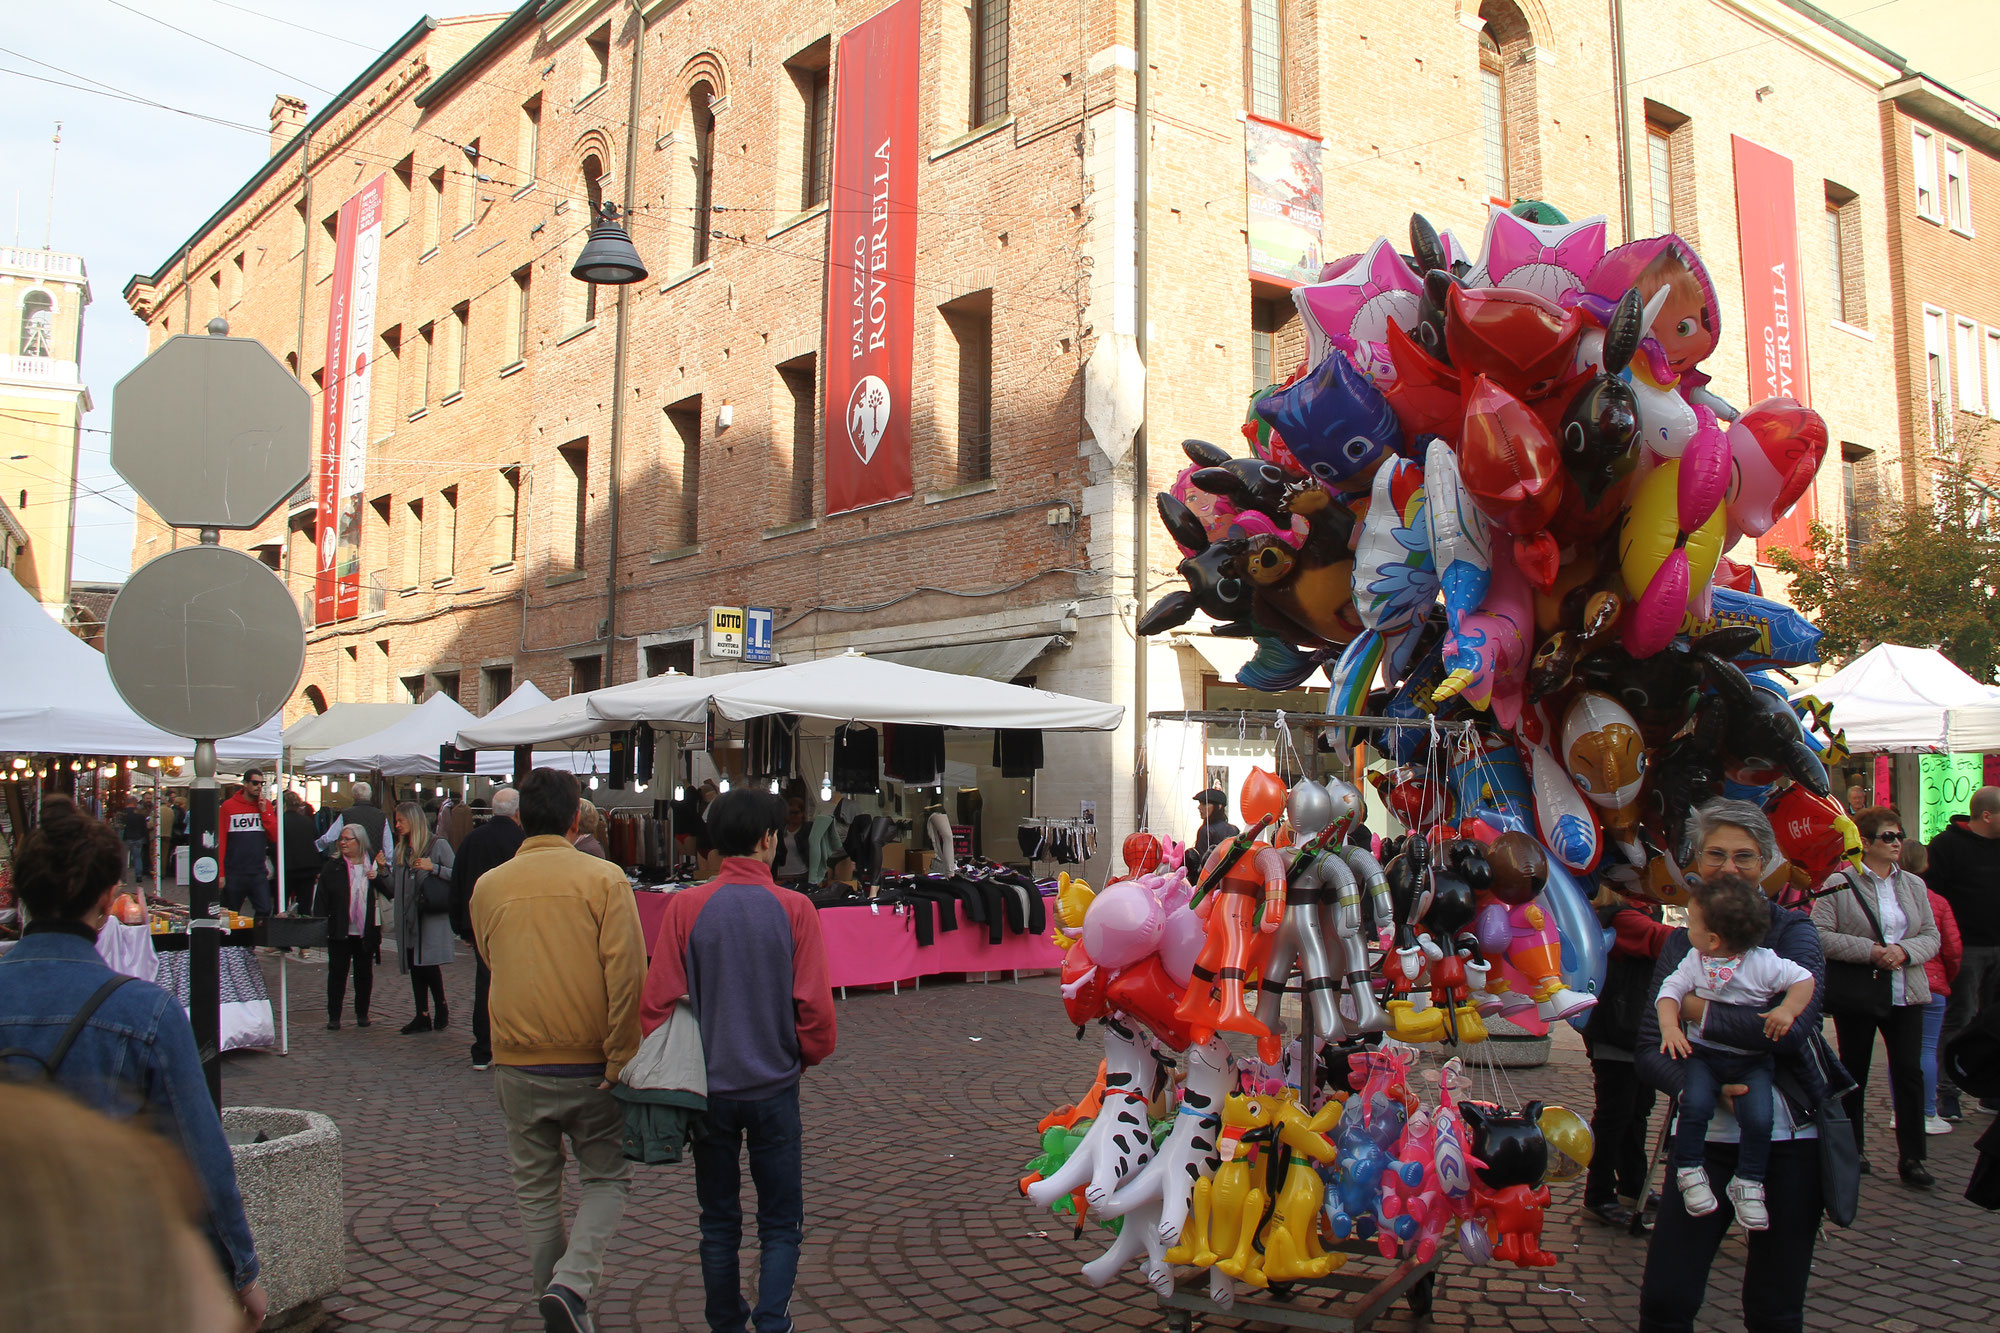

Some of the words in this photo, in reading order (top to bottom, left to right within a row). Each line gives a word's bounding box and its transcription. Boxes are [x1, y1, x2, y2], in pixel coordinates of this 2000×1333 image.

[869, 136, 891, 353] ROVERELLA
[852, 235, 866, 360] PALAZZO
[330, 293, 344, 416] ROVERELLA
[1763, 326, 1777, 399] LAZZO
[326, 422, 337, 514] PALAZZO
[717, 613, 741, 628] LOTTO
[749, 610, 771, 647] T
[1711, 610, 1769, 624] AZING
[1921, 757, 1953, 773] SUPER
[1922, 776, 1970, 806] 3,00
